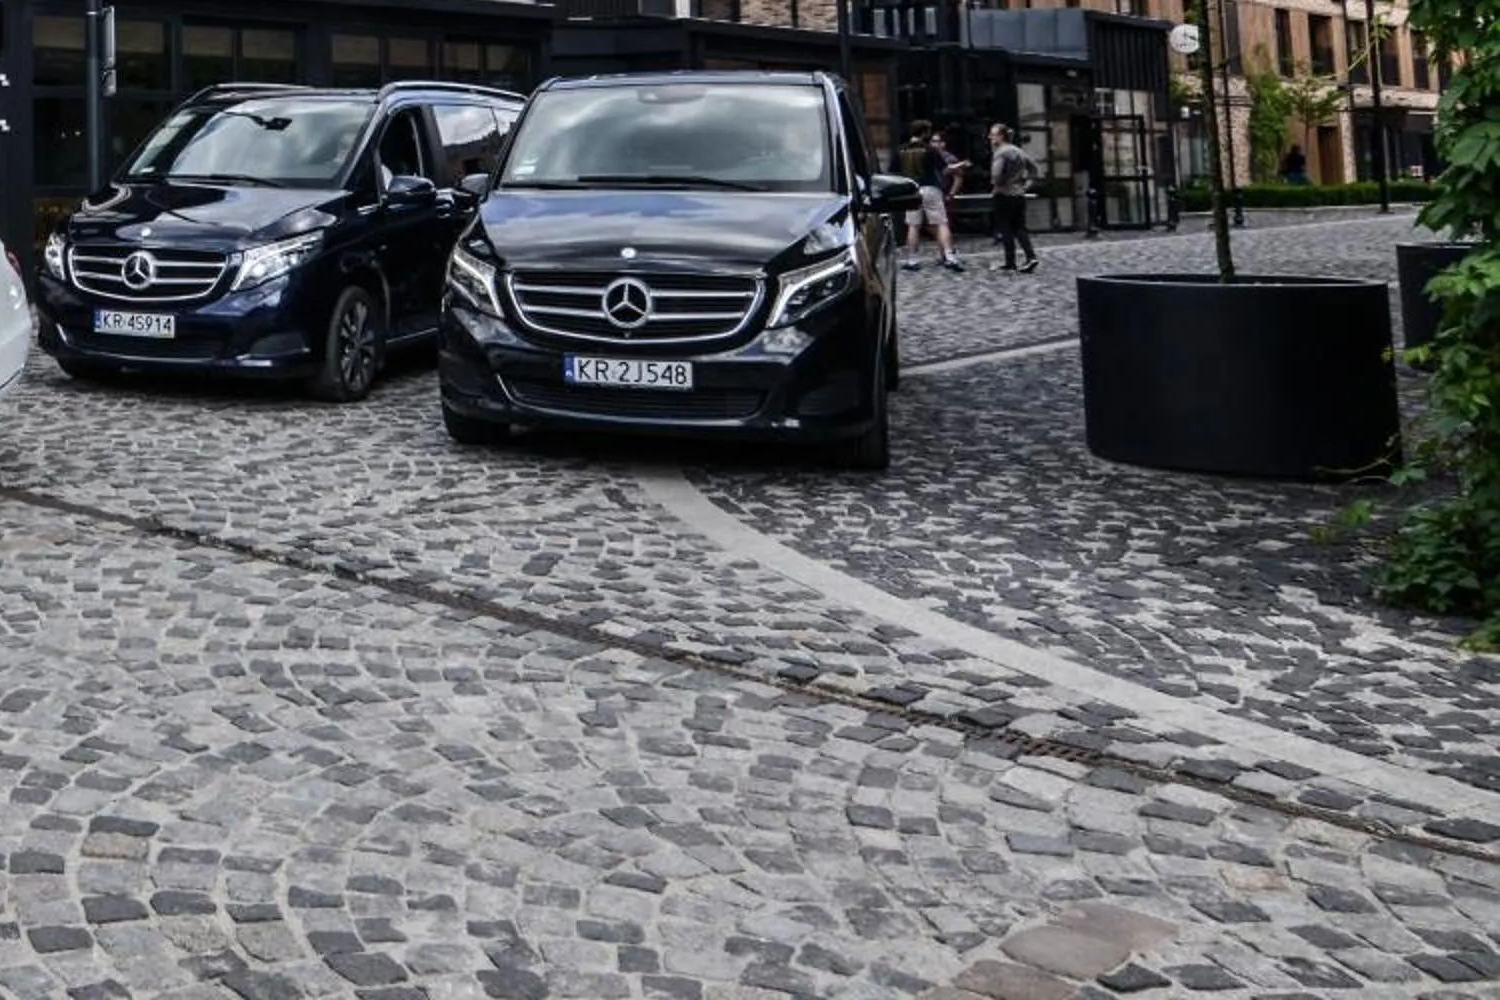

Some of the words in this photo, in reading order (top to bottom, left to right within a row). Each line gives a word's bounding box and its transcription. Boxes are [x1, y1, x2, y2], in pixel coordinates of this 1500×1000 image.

[103, 313, 123, 329] KR
[127, 314, 172, 333] 4S914
[578, 359, 609, 381] KR
[617, 361, 688, 385] 2J548
